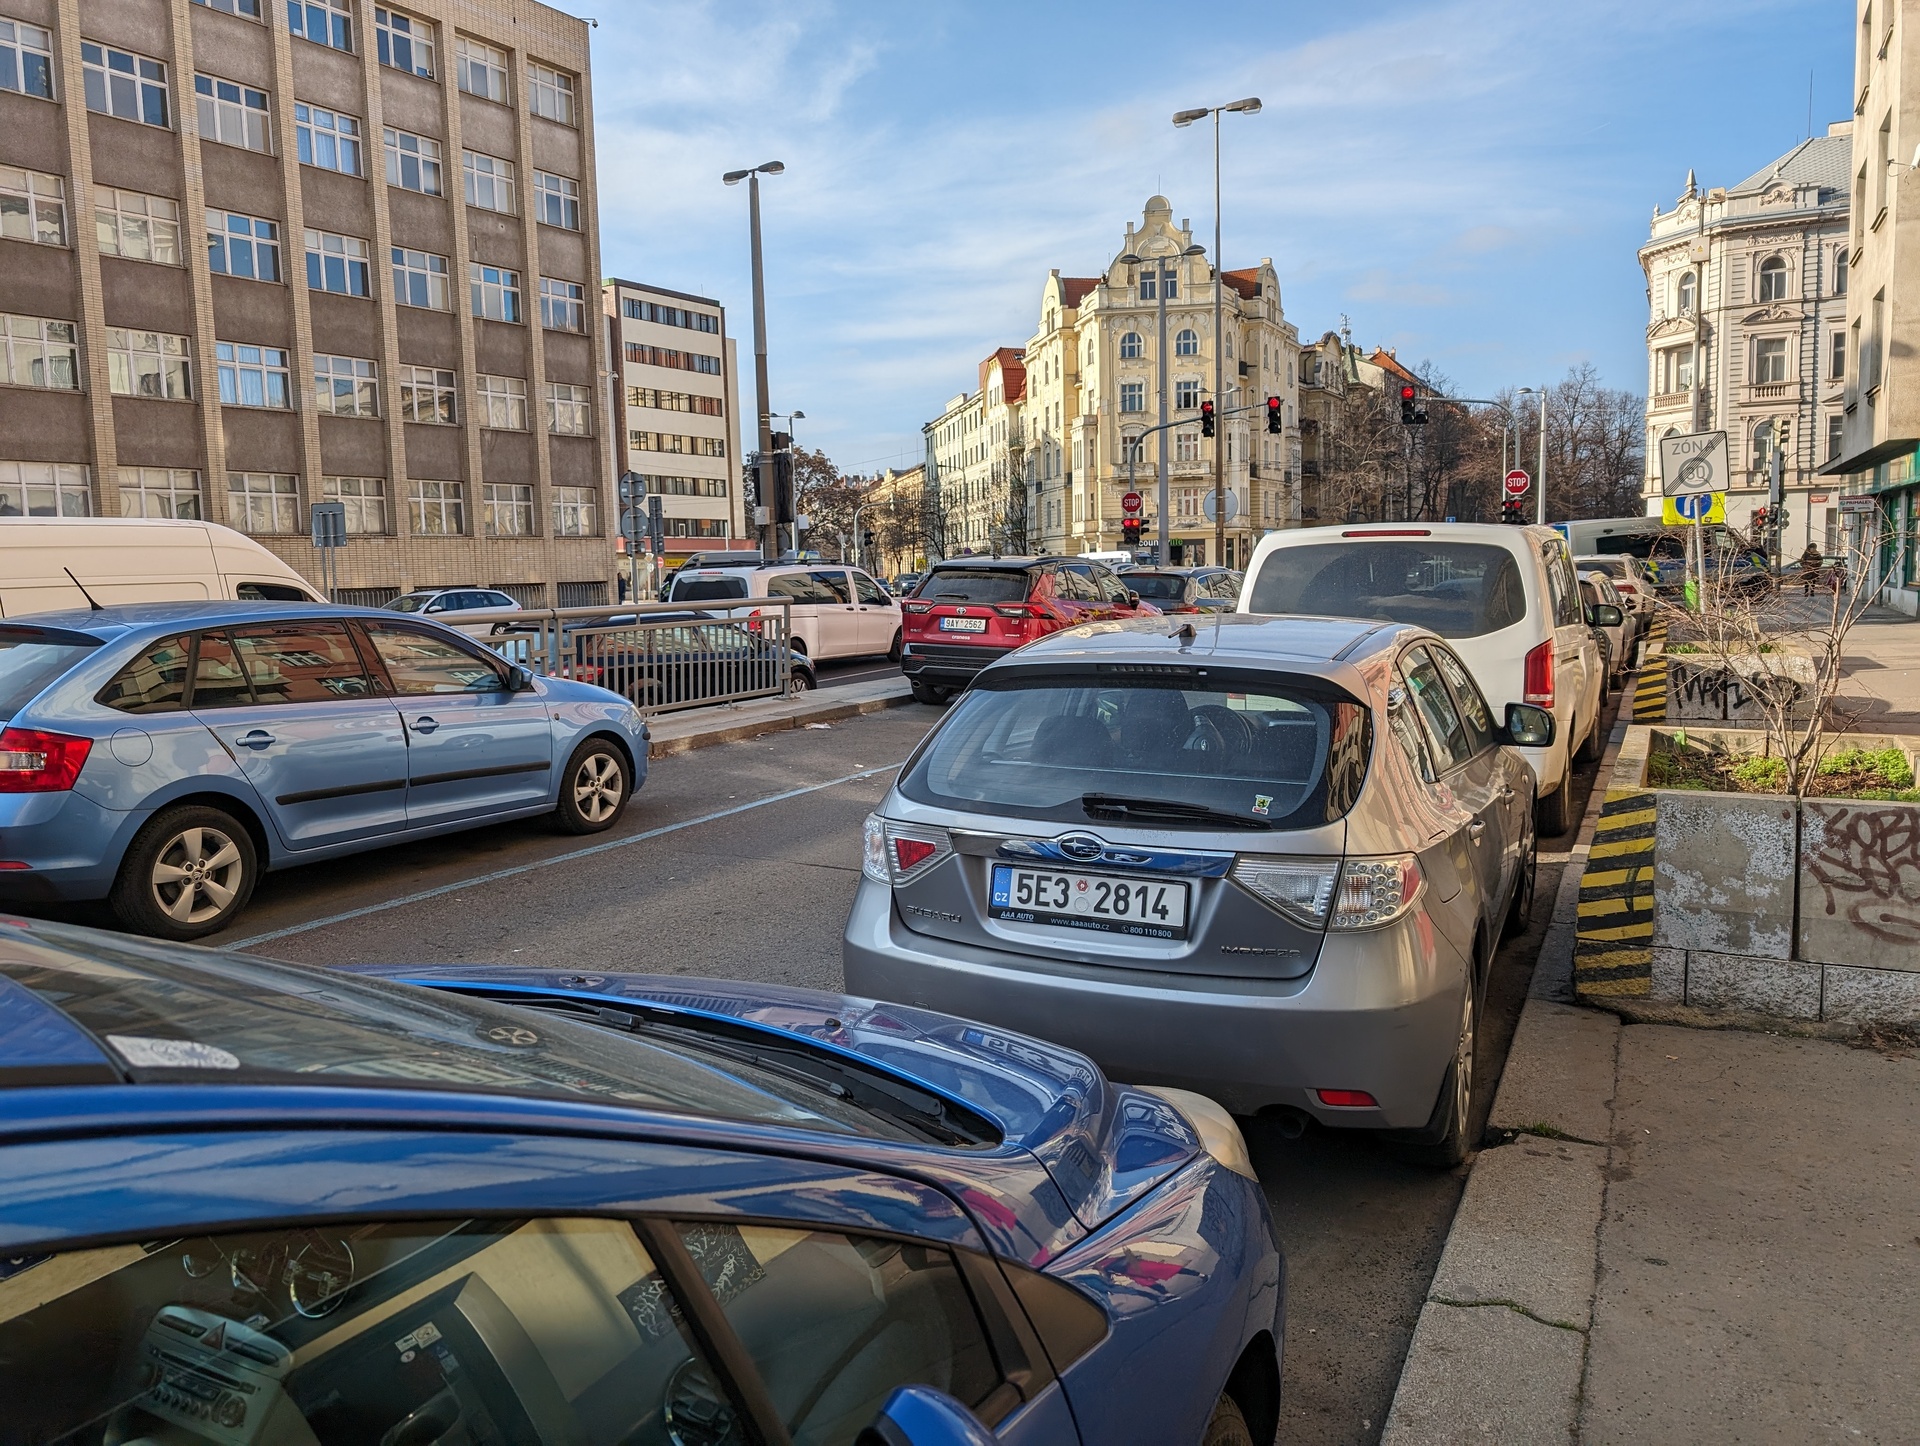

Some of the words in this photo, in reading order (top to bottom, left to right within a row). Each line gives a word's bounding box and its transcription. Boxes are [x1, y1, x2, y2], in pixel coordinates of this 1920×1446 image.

[1671, 439, 1715, 456] ZÓNA
[1507, 477, 1527, 487] STOP
[1123, 498, 1140, 507] STOP
[945, 619, 959, 628] 9AY
[964, 620, 983, 629] 2562
[994, 892, 1008, 902] CZ
[1016, 873, 1071, 909] 5E3
[1093, 881, 1169, 921] 2814
[906, 905, 962, 923] SUBARU
[1050, 917, 1110, 931] www.aaaauto.cz
[1129, 926, 1143, 934] 800
[1144, 928, 1157, 936] 110
[1158, 929, 1172, 938] 800
[1220, 945, 1301, 958] IMPREZA
